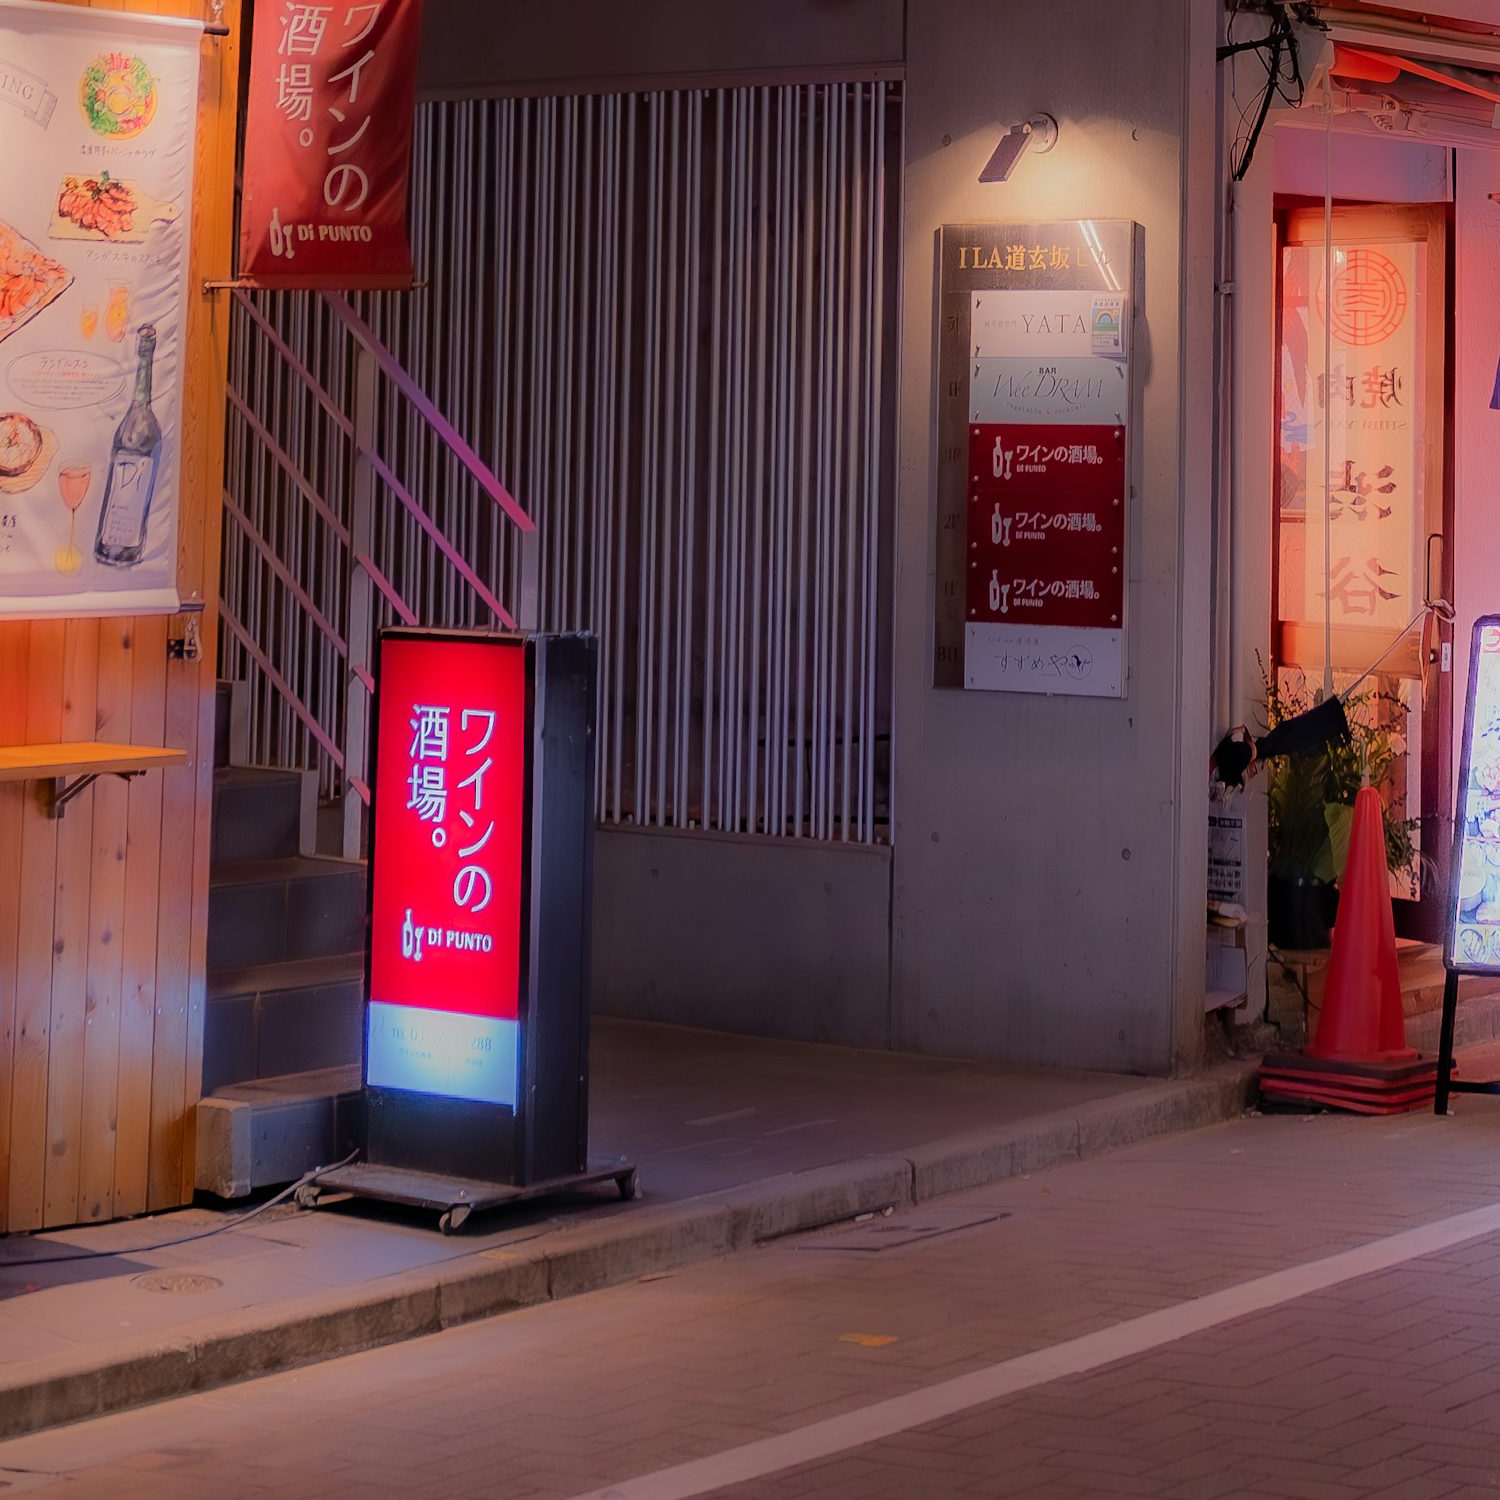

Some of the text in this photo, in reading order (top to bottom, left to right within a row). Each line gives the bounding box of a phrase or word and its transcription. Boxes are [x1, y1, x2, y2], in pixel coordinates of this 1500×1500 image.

[275, 1, 333, 149] 酒場。
[0, 73, 35, 101] ING
[322, 1, 383, 213] ワインの
[319, 223, 373, 244] PUNTO
[1022, 315, 1087, 333] YATA
[1039, 367, 1057, 375] BAR
[1016, 445, 1103, 465] ワインの酒場。
[1015, 512, 1102, 533] ワインの酒場。
[1013, 579, 1100, 600] ワインの酒場。
[406, 703, 451, 850] 酒場。
[452, 707, 497, 914] ワインの
[446, 930, 493, 953] PUNTO
